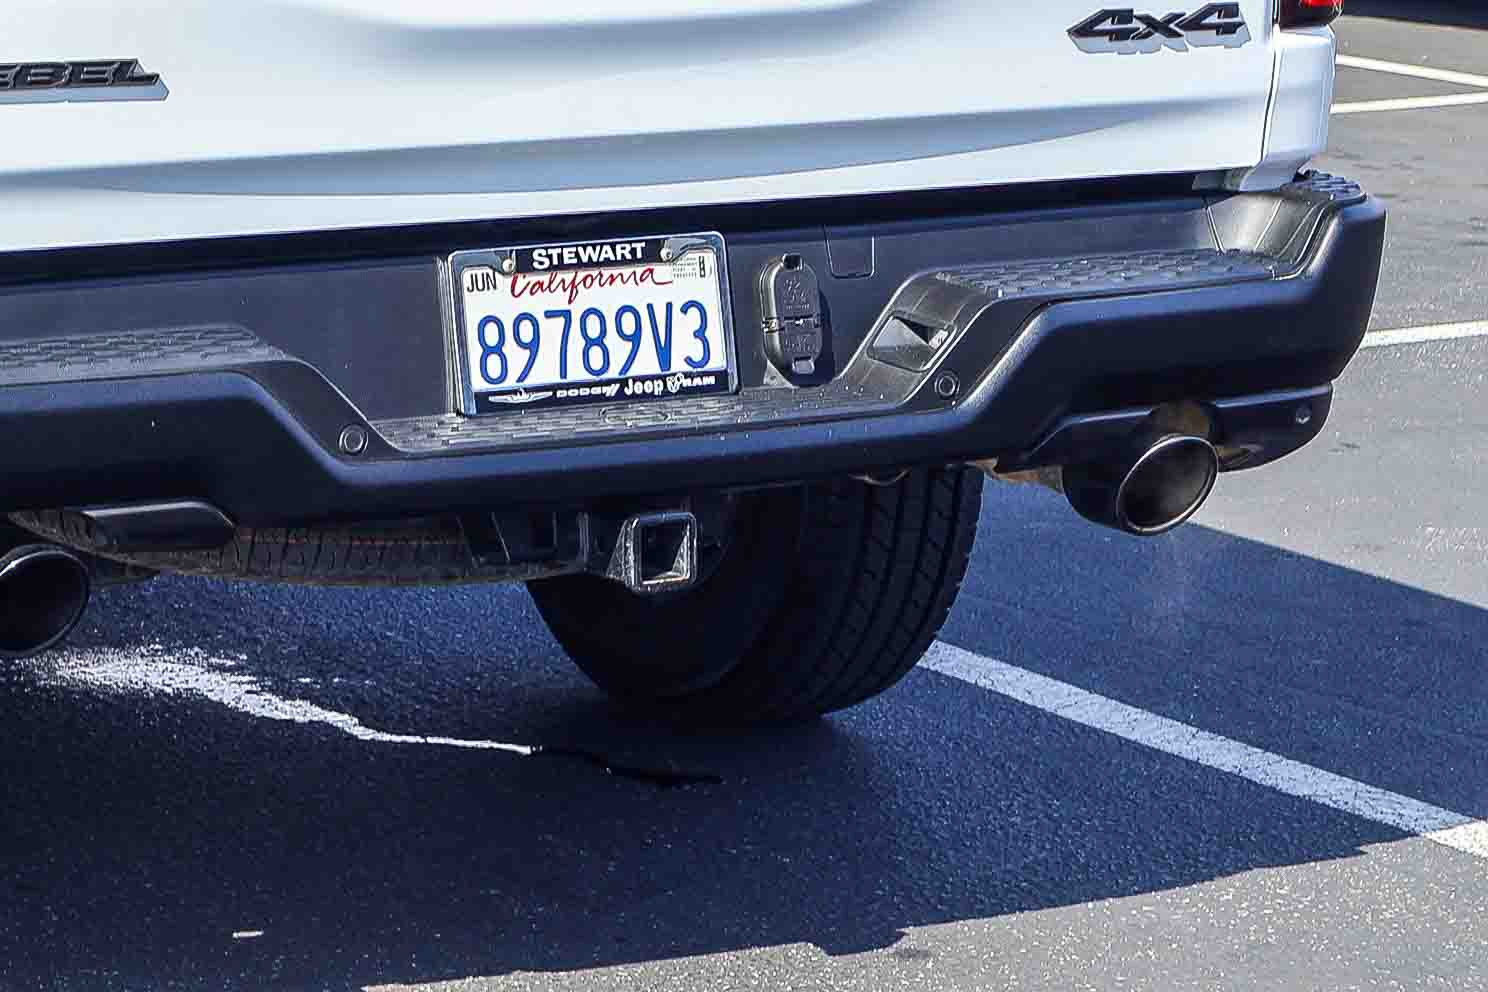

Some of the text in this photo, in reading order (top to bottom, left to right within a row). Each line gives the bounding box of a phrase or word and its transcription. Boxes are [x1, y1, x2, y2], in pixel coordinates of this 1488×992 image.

[532, 242, 646, 270] STEWART
[466, 270, 498, 293] JUN
[511, 265, 672, 304] California
[478, 300, 711, 385] 89789V3
[624, 378, 664, 396] Jeep
